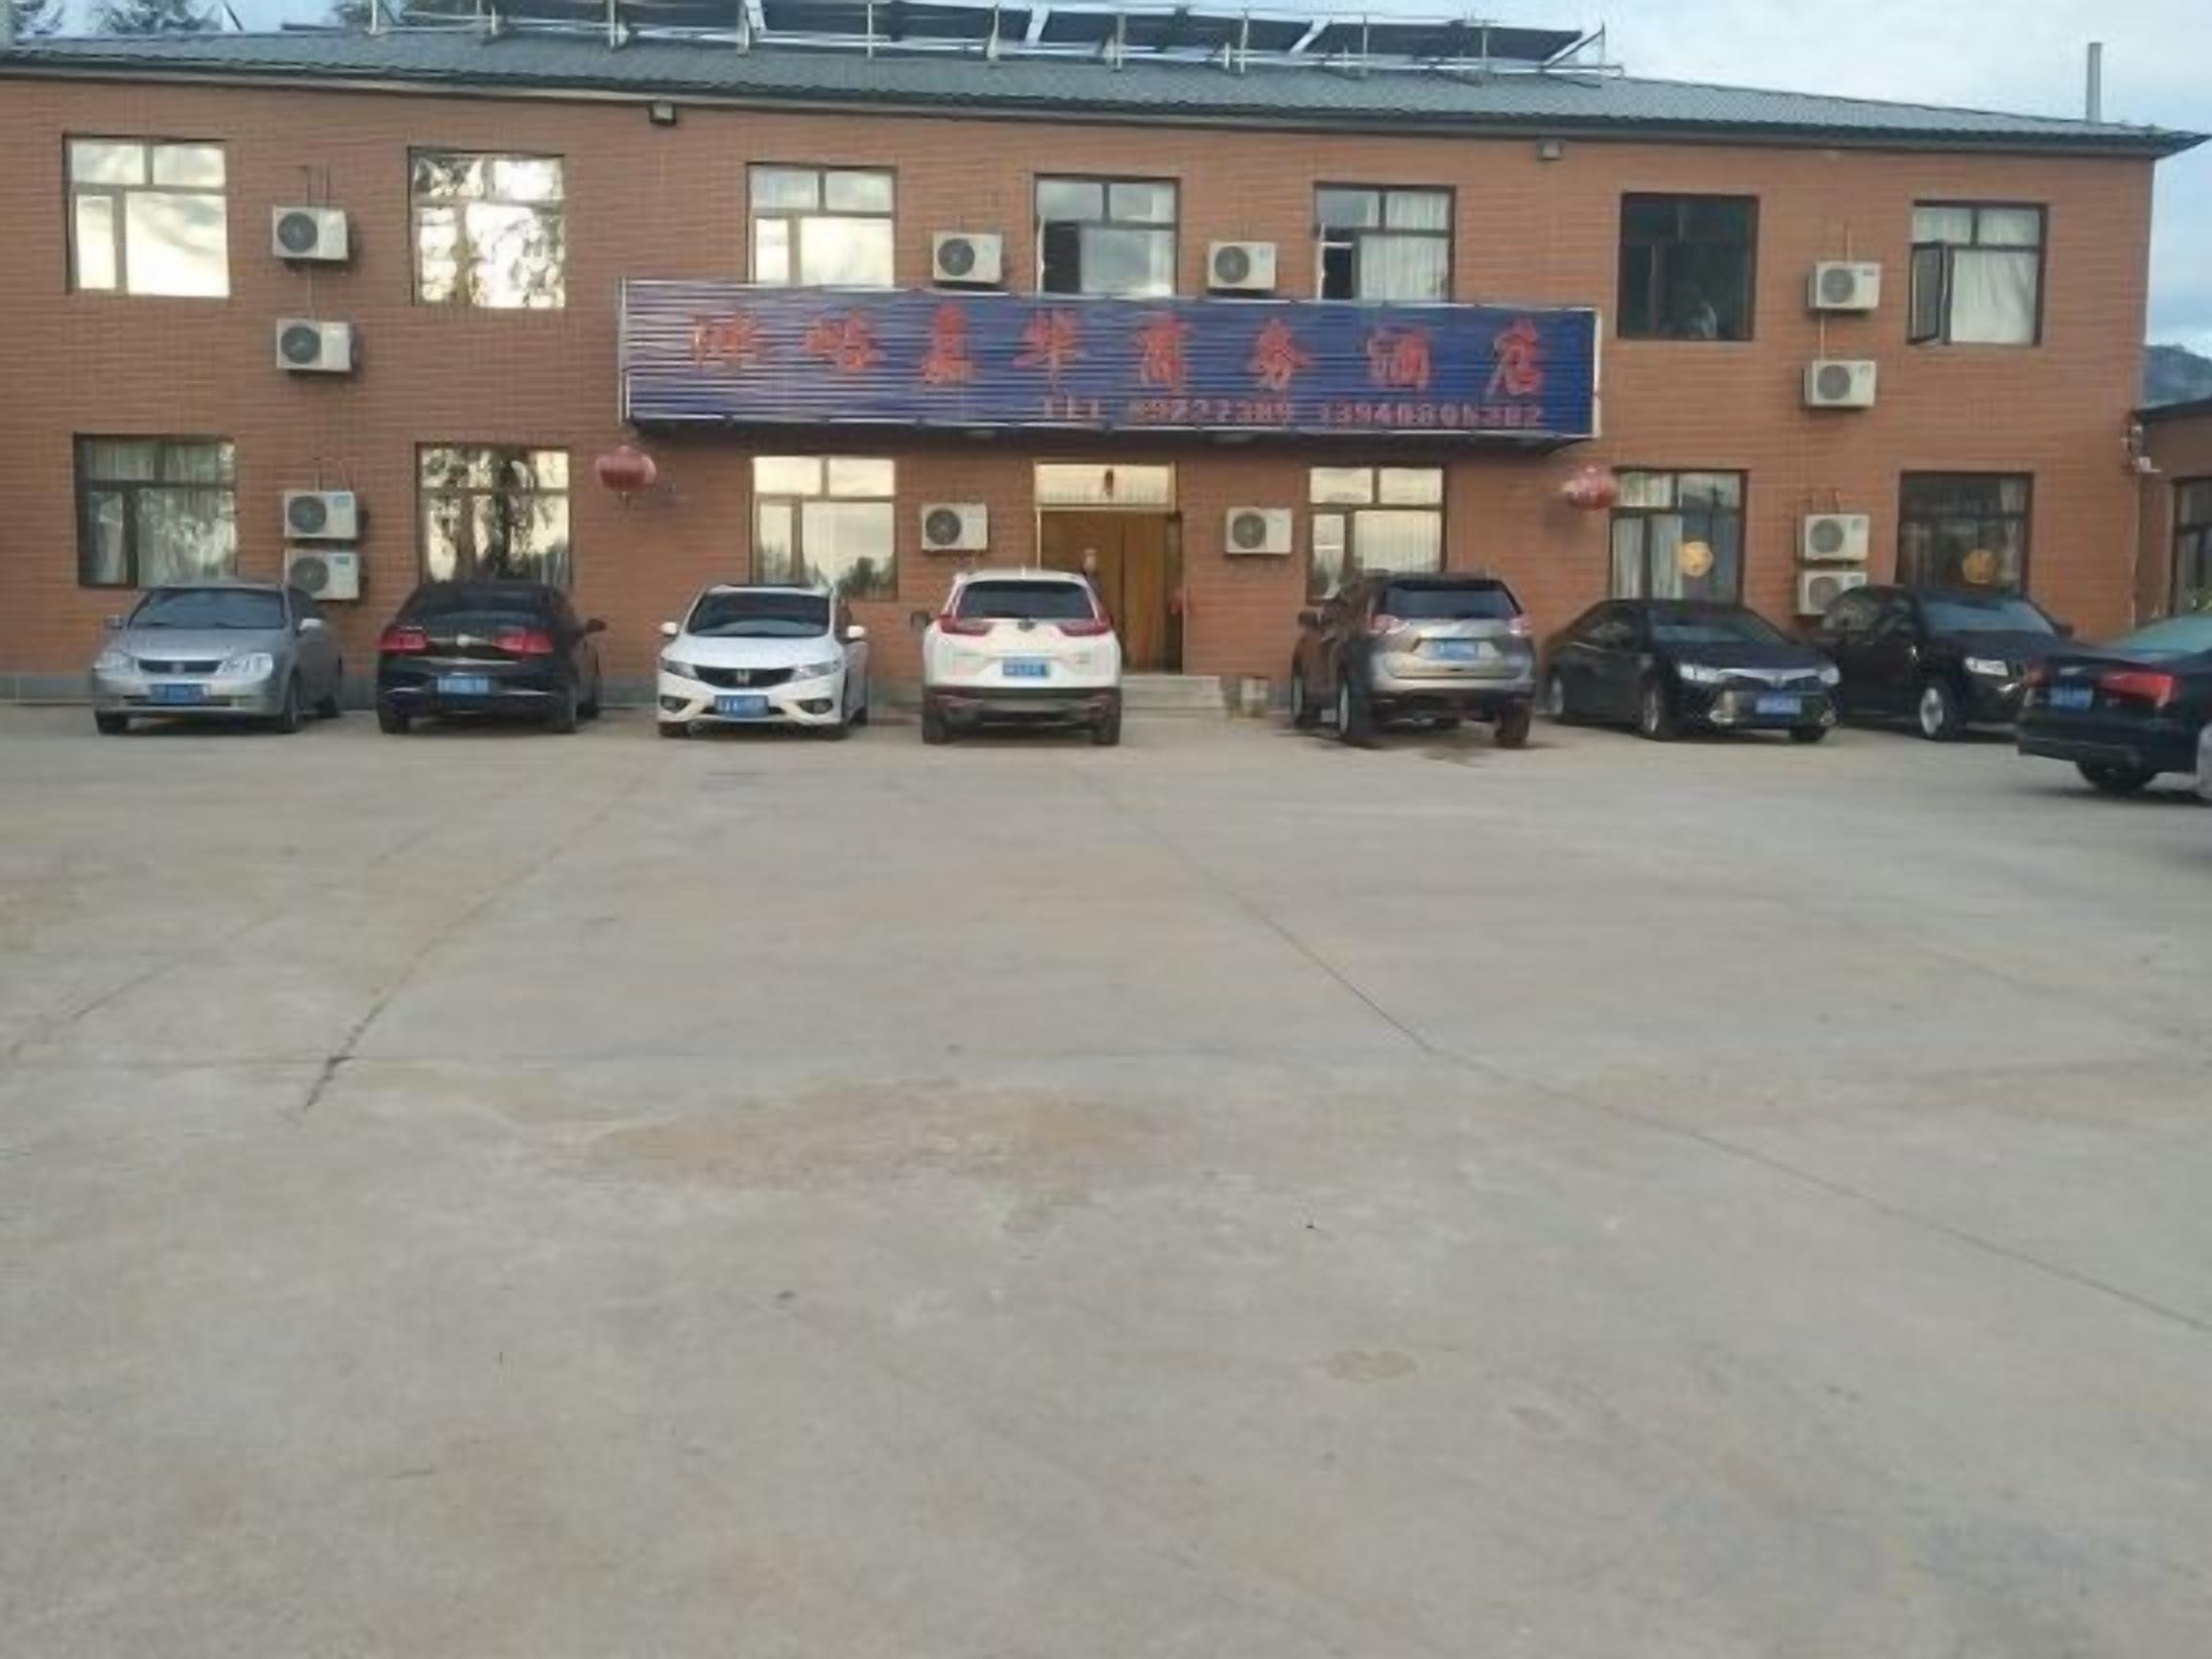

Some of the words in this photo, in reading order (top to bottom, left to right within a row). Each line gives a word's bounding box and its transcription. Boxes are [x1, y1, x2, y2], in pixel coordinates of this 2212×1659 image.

[689, 305, 1548, 399] 嘉华商务酒店
